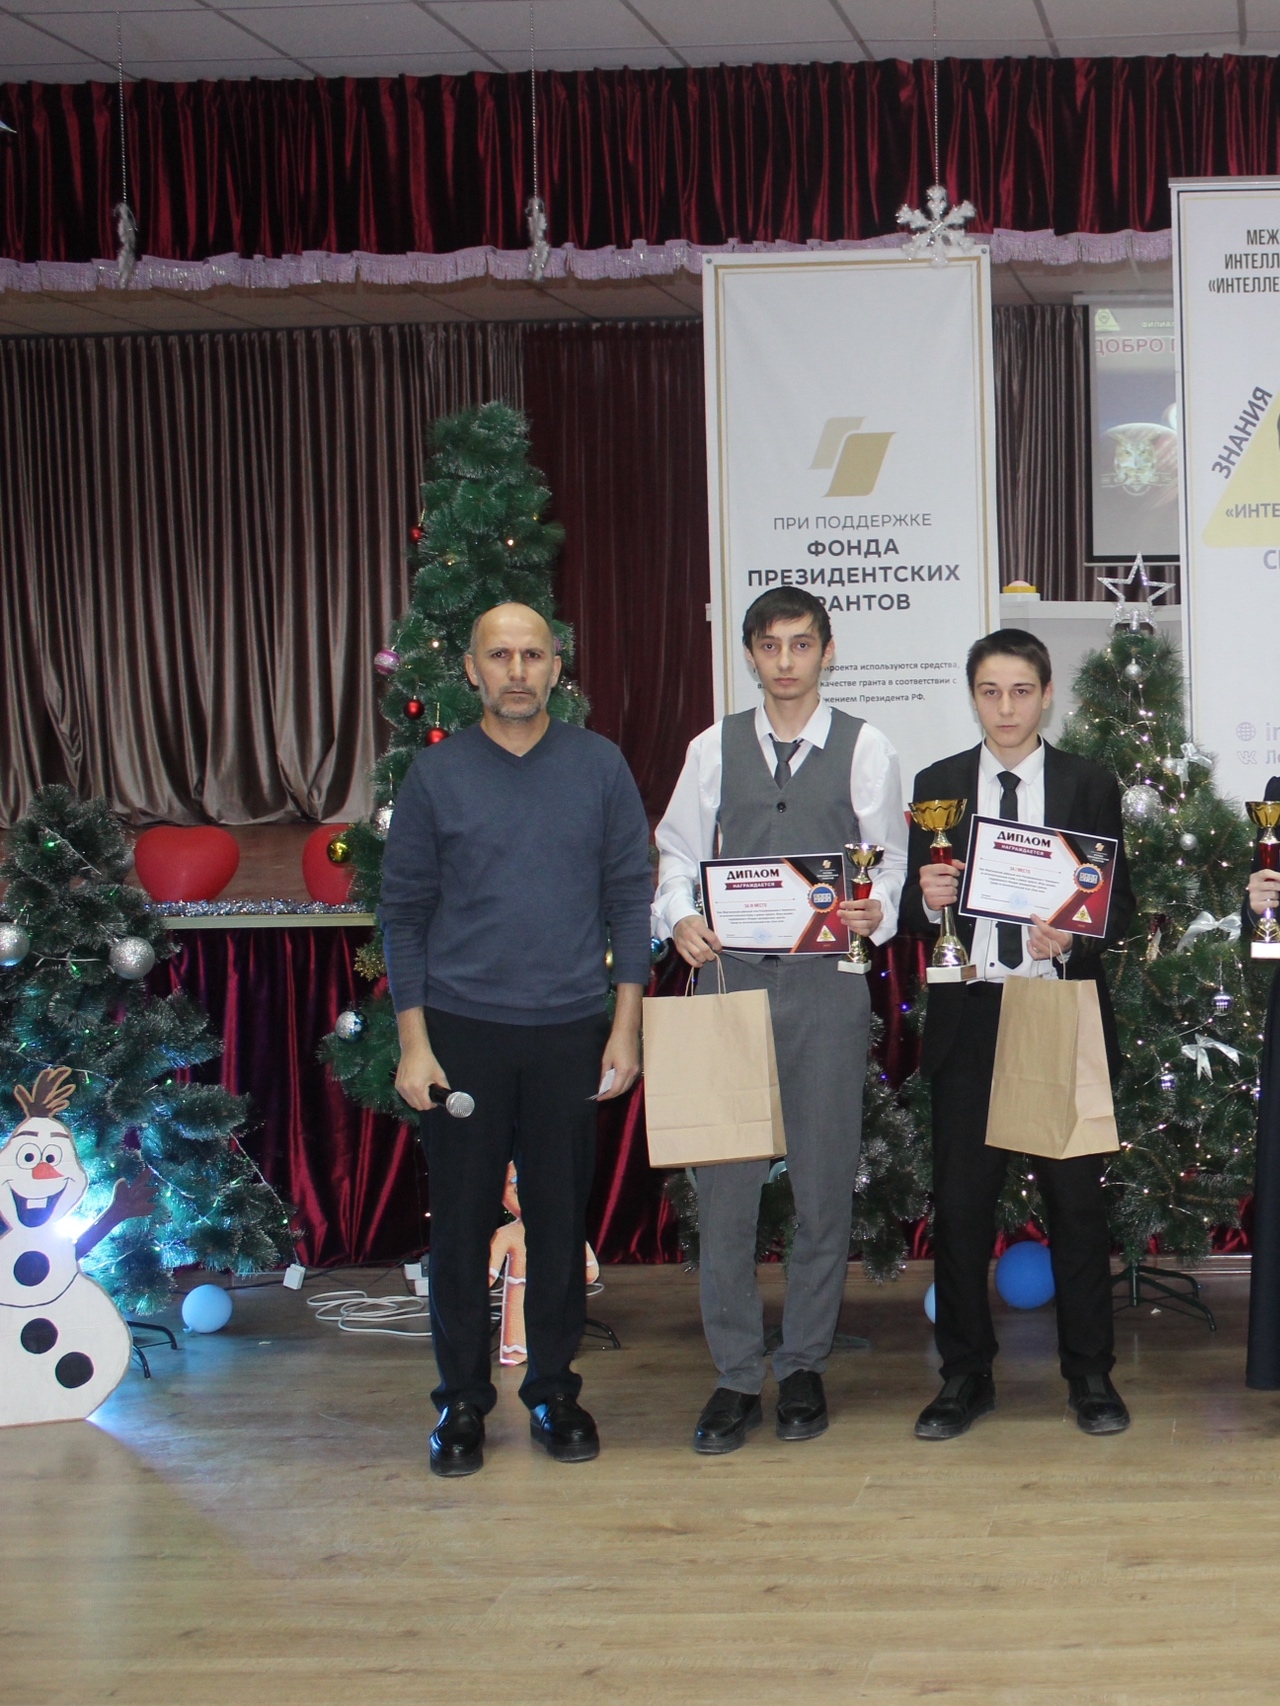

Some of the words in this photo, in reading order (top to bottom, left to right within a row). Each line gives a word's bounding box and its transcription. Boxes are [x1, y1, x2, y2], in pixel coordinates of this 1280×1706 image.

[1211, 386, 1273, 479] ЗНАНИЯ
[773, 516, 809, 530] ПРИ
[815, 513, 932, 530] ПОДДЕРЖКЕ
[807, 538, 900, 558] ФОНДА
[748, 564, 961, 587] ПРЕЗИДЕНТСКИХ
[815, 593, 911, 612] АНТОВ
[860, 663, 918, 671] используются
[820, 680, 857, 688] качестве
[859, 680, 887, 688] гранта
[859, 694, 909, 703] Президента
[996, 831, 1051, 848] ДИПЛОМ
[726, 868, 780, 880] ДИПЛОМ
